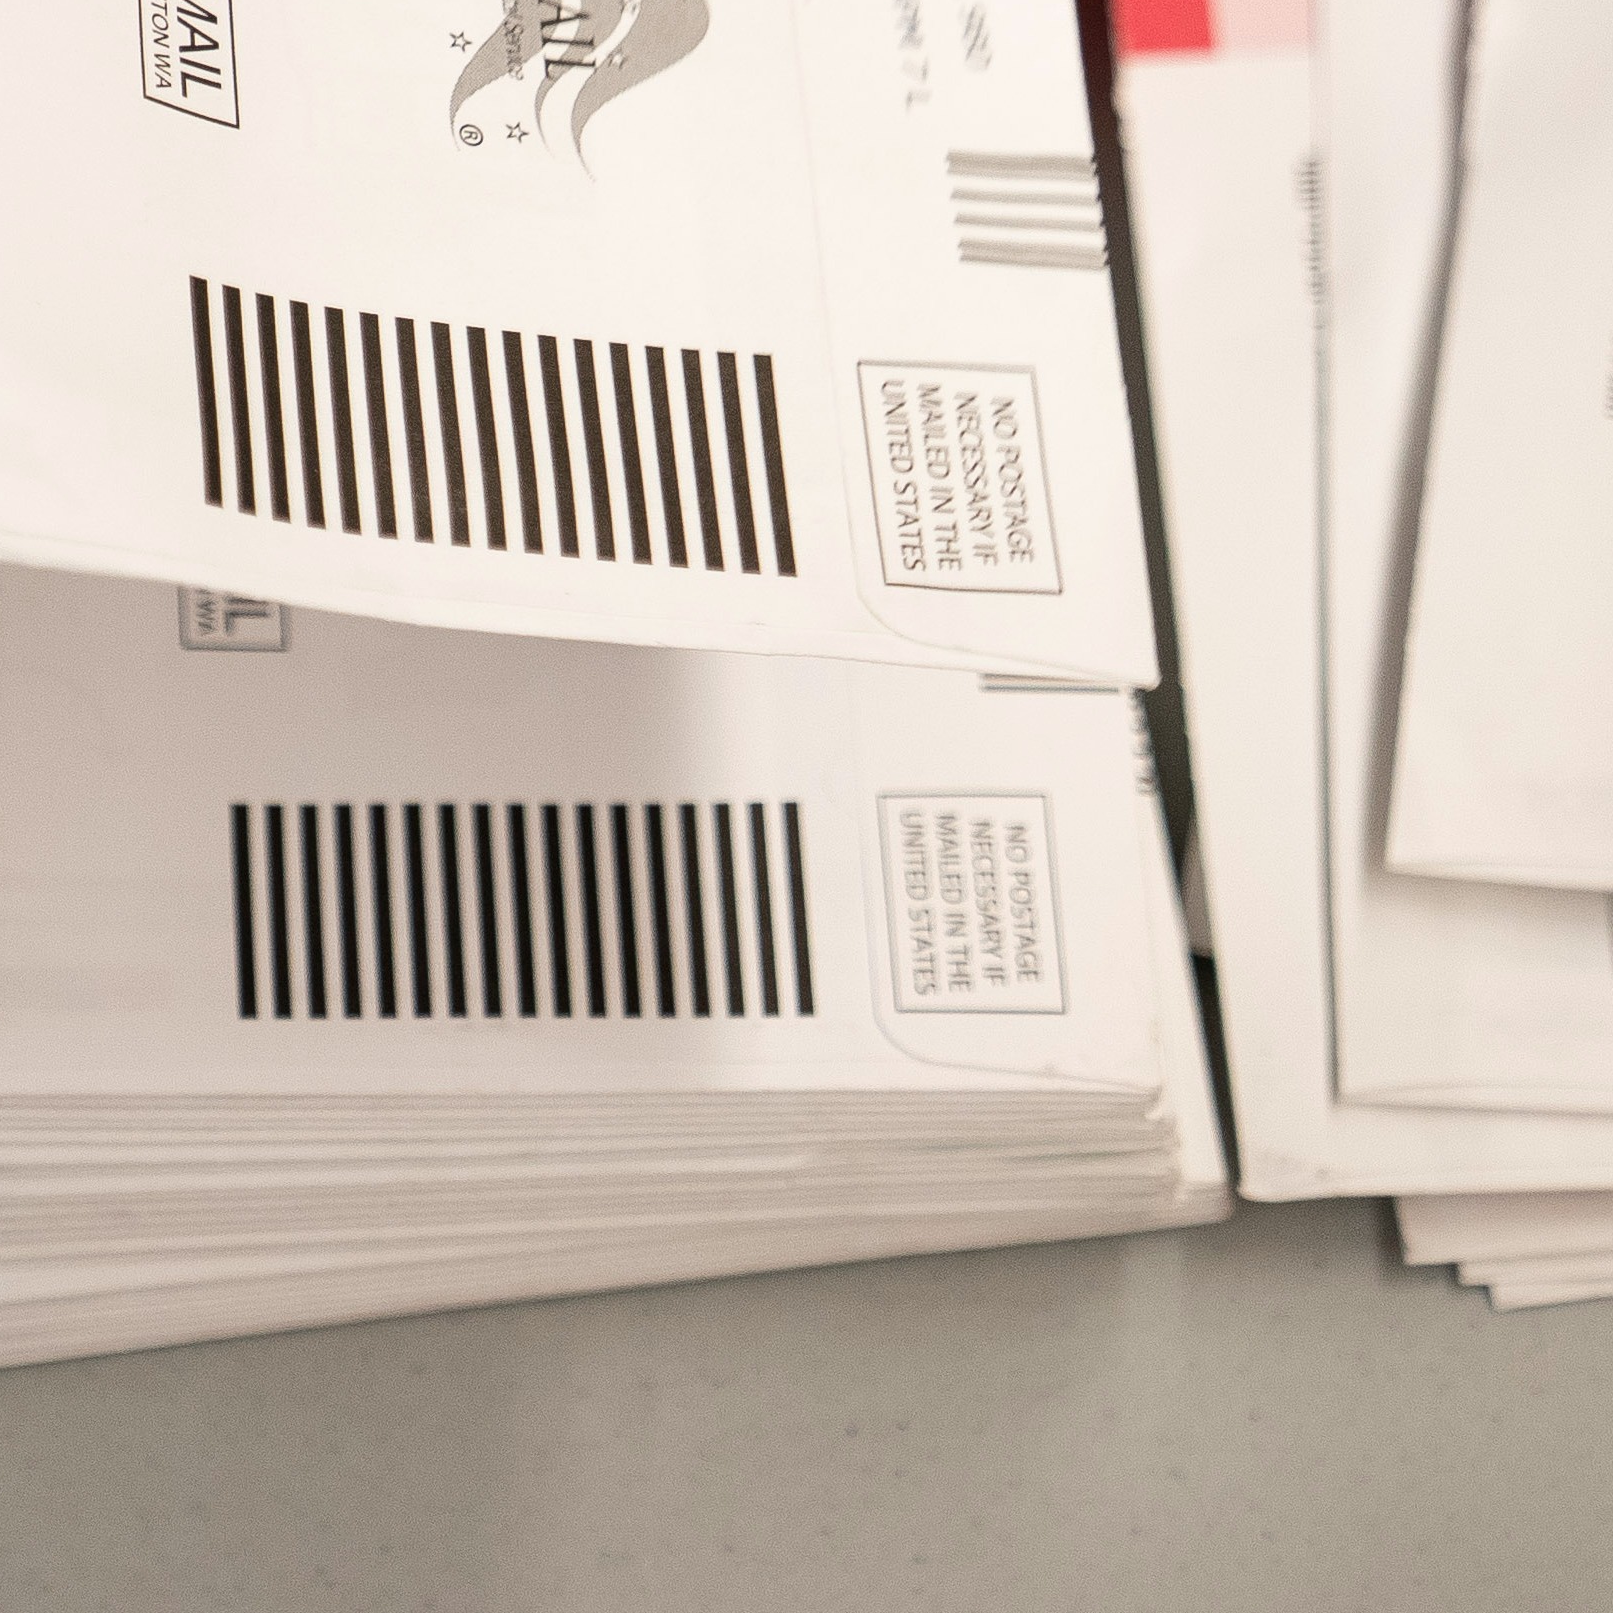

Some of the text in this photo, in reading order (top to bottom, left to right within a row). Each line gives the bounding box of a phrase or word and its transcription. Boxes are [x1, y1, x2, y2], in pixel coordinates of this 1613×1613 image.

[155, 53, 172, 89] WA
[881, 381, 927, 570] UNITED STATES
[919, 385, 962, 569] MAILED IN THE
[957, 394, 998, 563] NECESSARY IF
[993, 399, 1034, 560] NO POSTAGE
[901, 812, 937, 994] UNITED STATES
[937, 813, 972, 988] MAILED IN THE
[972, 820, 1006, 984] NECESSARY IF
[1007, 824, 1040, 979] NO POSTAGE
